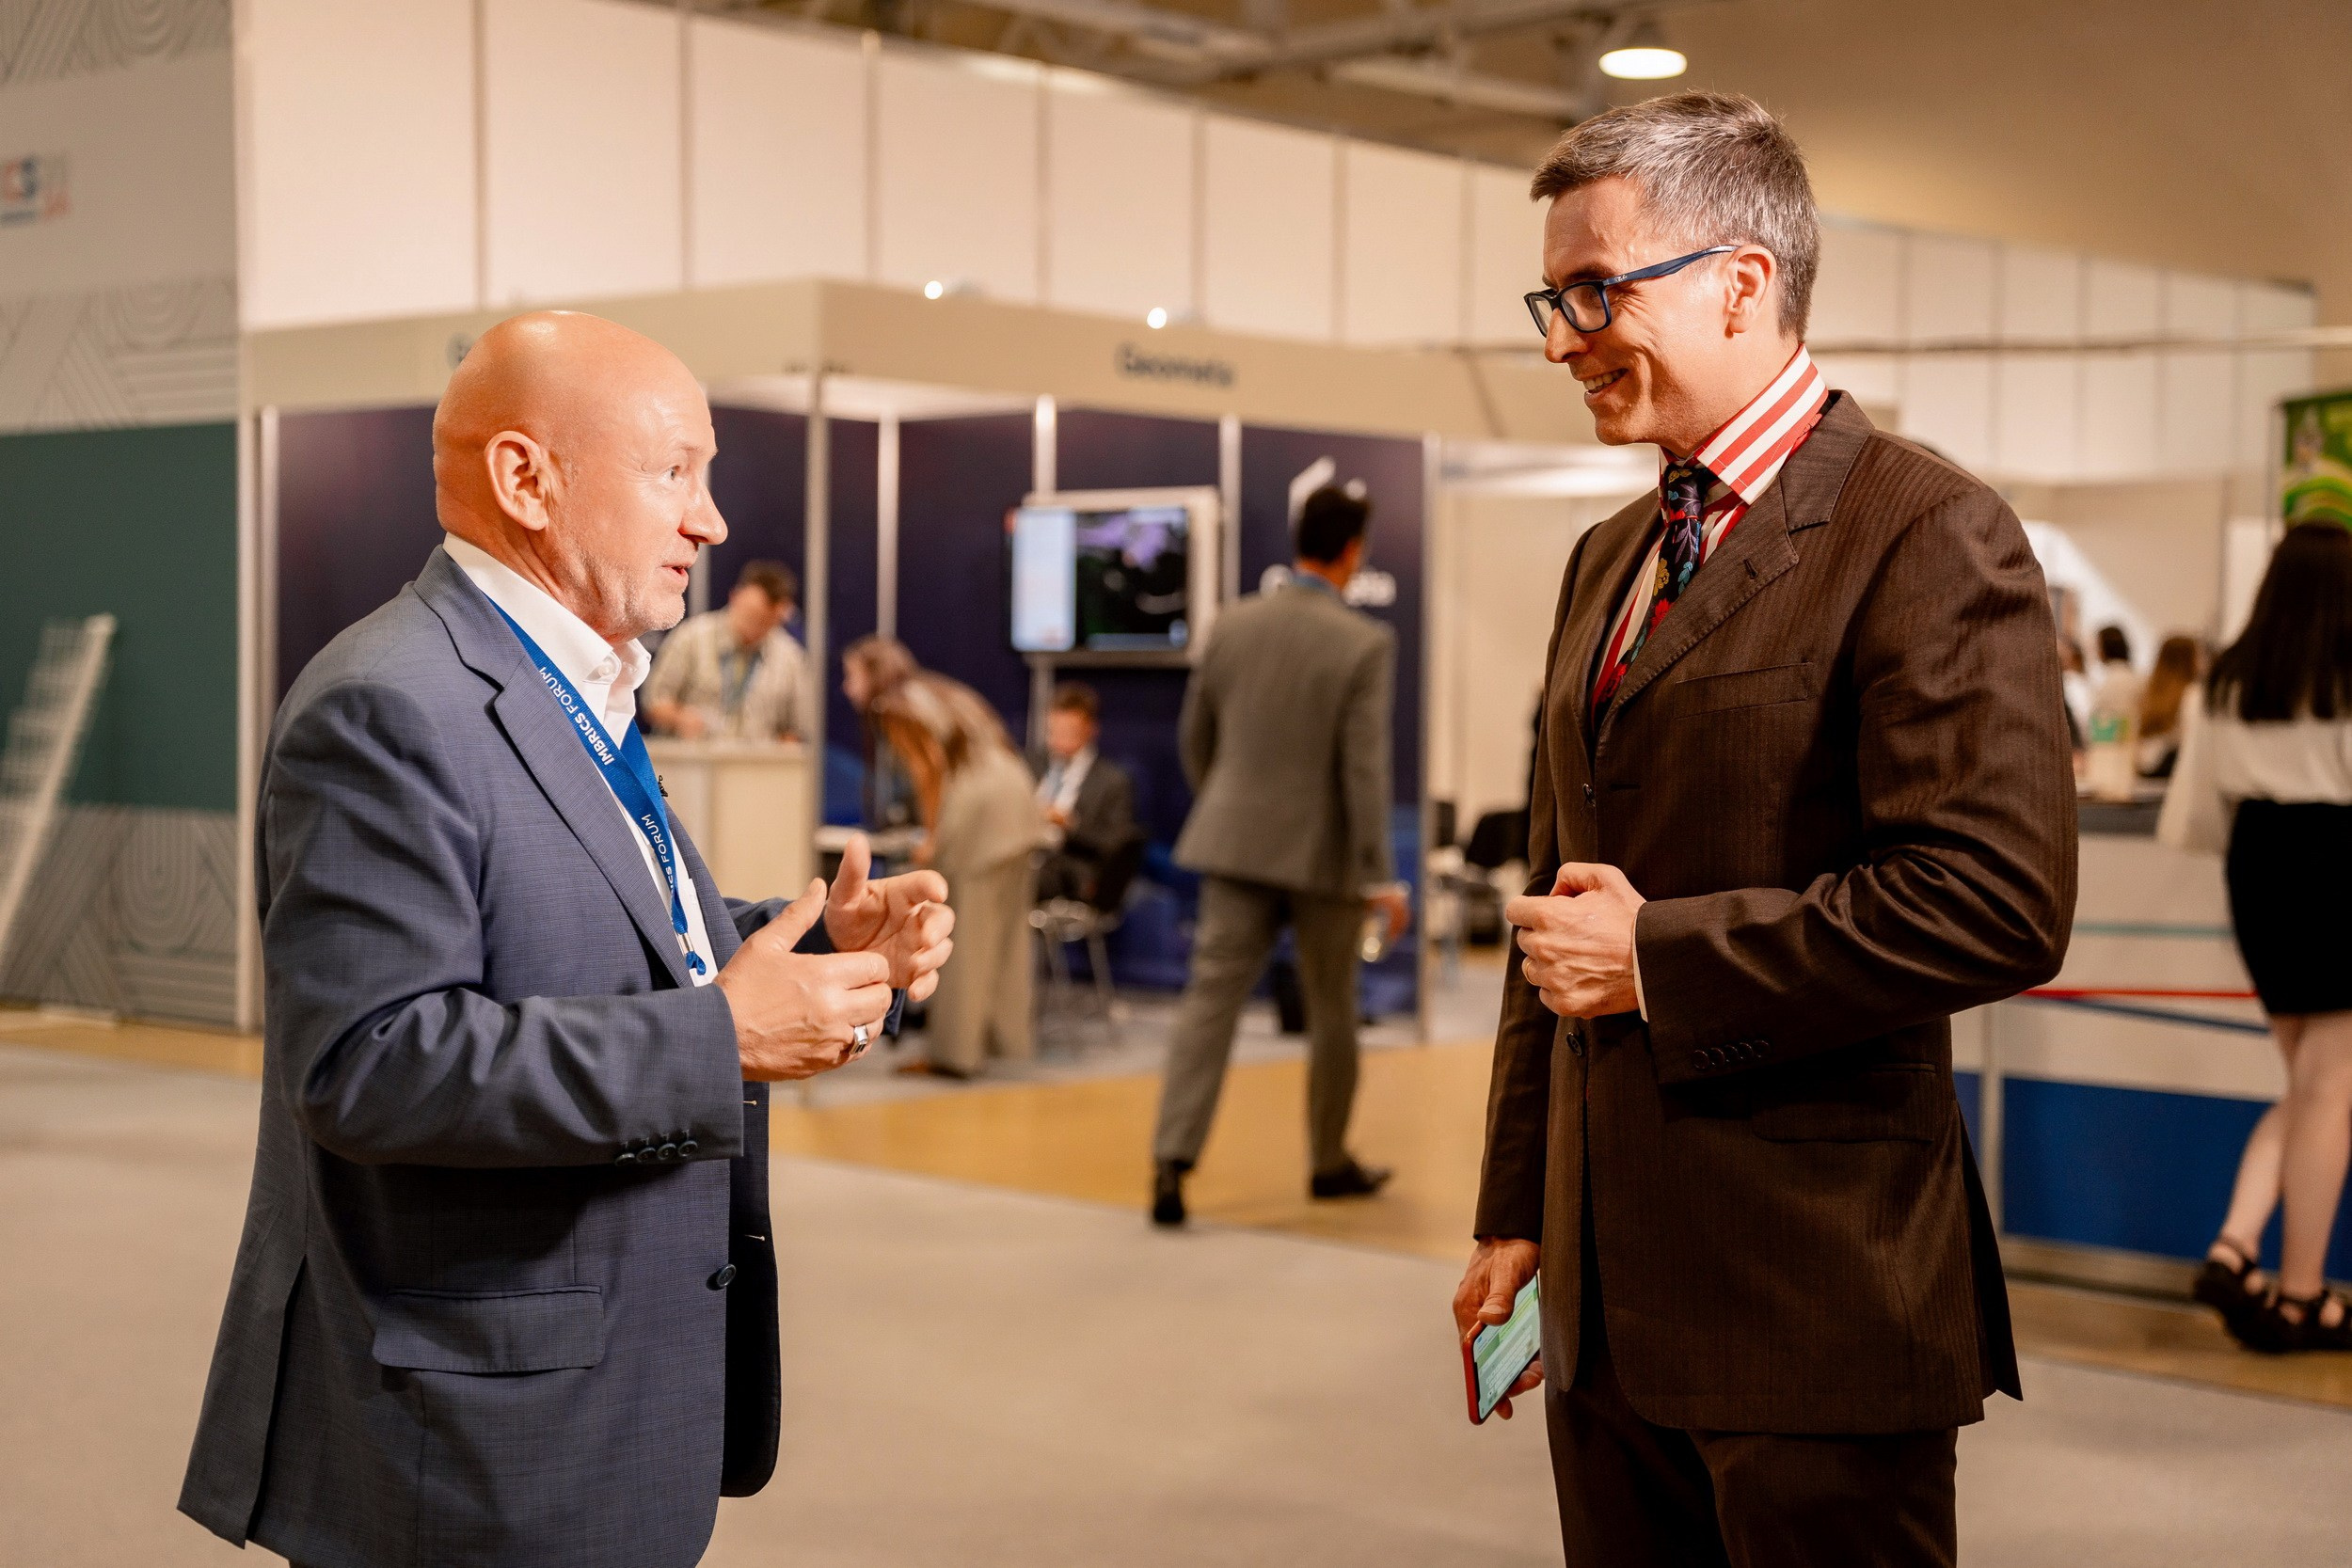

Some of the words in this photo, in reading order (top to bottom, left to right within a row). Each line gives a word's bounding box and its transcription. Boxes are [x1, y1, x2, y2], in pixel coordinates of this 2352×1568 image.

[539, 667, 579, 714] FORUM
[574, 712, 614, 766] IMBRICS
[642, 814, 669, 863] FORUM
